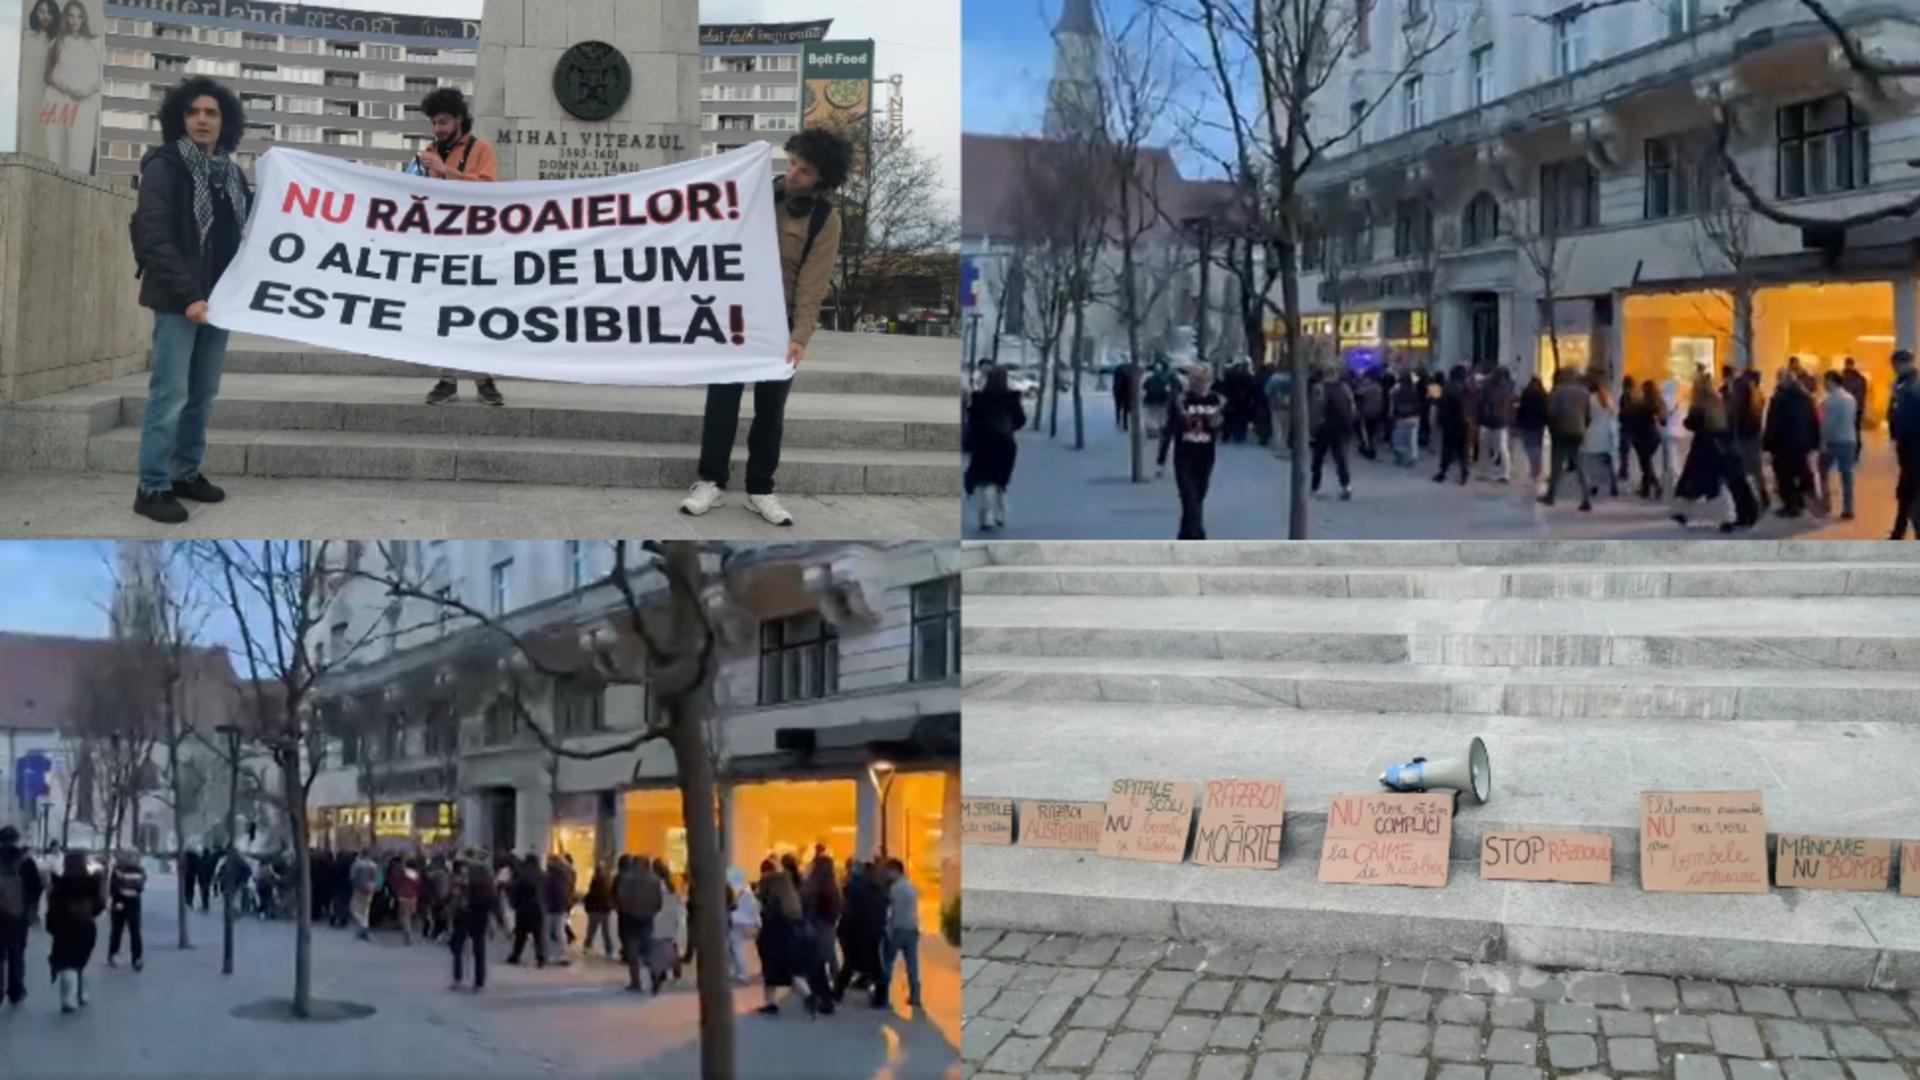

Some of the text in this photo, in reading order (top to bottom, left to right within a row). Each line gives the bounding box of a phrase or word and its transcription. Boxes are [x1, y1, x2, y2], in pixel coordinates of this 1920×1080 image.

[809, 53, 867, 67] Bolt Food
[496, 129, 684, 150] MIHAI VITEAZUL
[538, 159, 579, 170] DOMN
[282, 180, 741, 236] NU RĂZBOAIELOR!
[269, 232, 744, 286] O ALTFEL DE LUME
[249, 280, 745, 345] ESTE POSIBILĂ!
[1106, 815, 1133, 832] NU
[1330, 799, 1364, 827] NU
[1374, 816, 1440, 835] COMPLICI
[1647, 816, 1676, 838] NU
[1353, 842, 1414, 864] CRIME
[1485, 836, 1544, 865] STOP
[1793, 858, 1820, 878] NU
